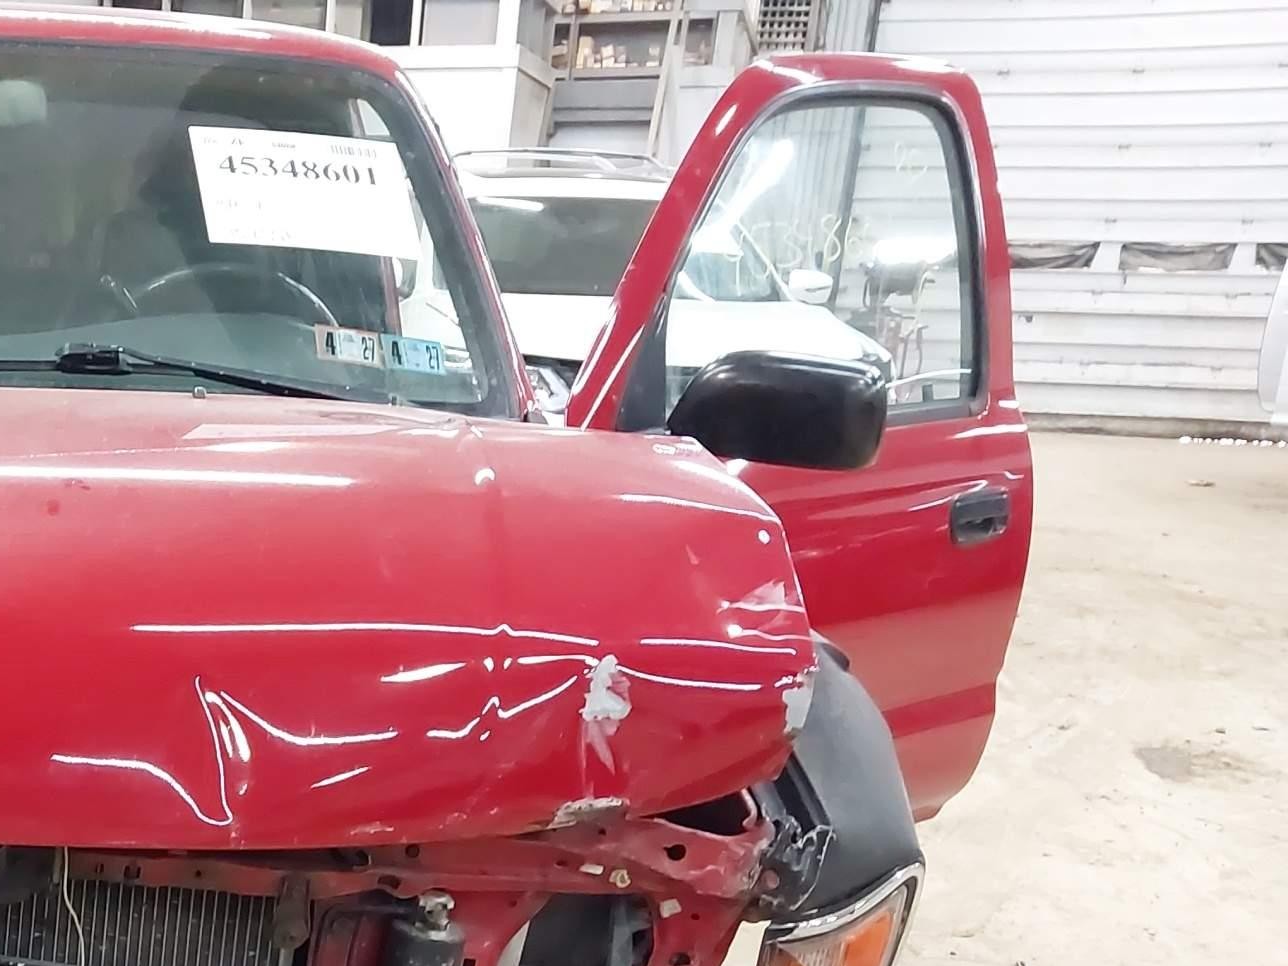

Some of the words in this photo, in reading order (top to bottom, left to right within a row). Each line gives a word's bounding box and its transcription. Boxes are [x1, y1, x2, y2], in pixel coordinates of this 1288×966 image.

[218, 154, 378, 186] 45348601
[325, 331, 337, 356] 4
[361, 336, 376, 362] 27
[391, 340, 403, 366] 4
[425, 345, 441, 371] 27
